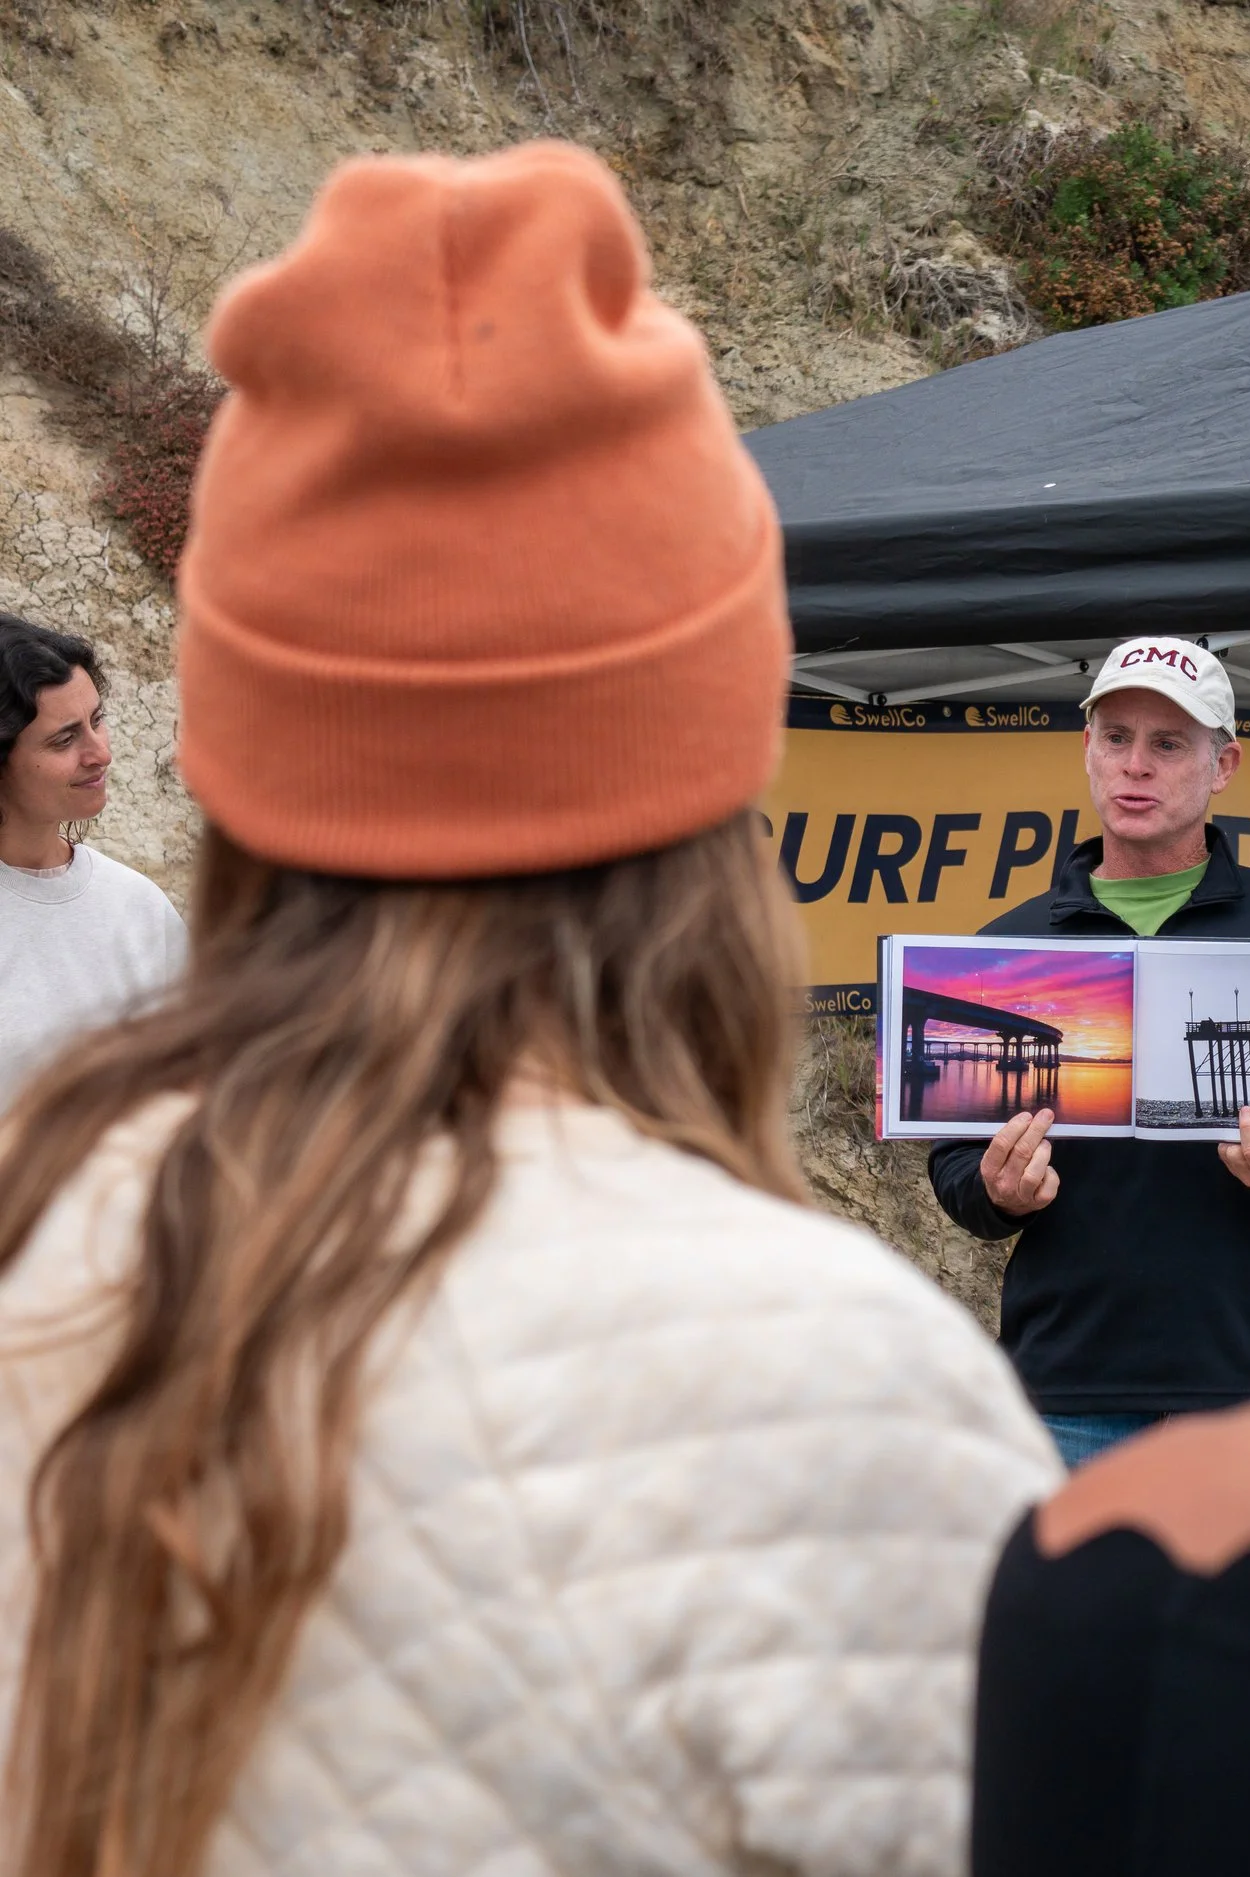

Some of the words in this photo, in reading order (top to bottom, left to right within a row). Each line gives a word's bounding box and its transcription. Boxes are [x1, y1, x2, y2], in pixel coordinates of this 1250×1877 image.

[1120, 646, 1198, 681] CMC
[854, 706, 926, 728] SwellCo
[987, 706, 1050, 727] SwellCo
[758, 809, 982, 904] URF
[804, 990, 872, 1013] SwellCo
